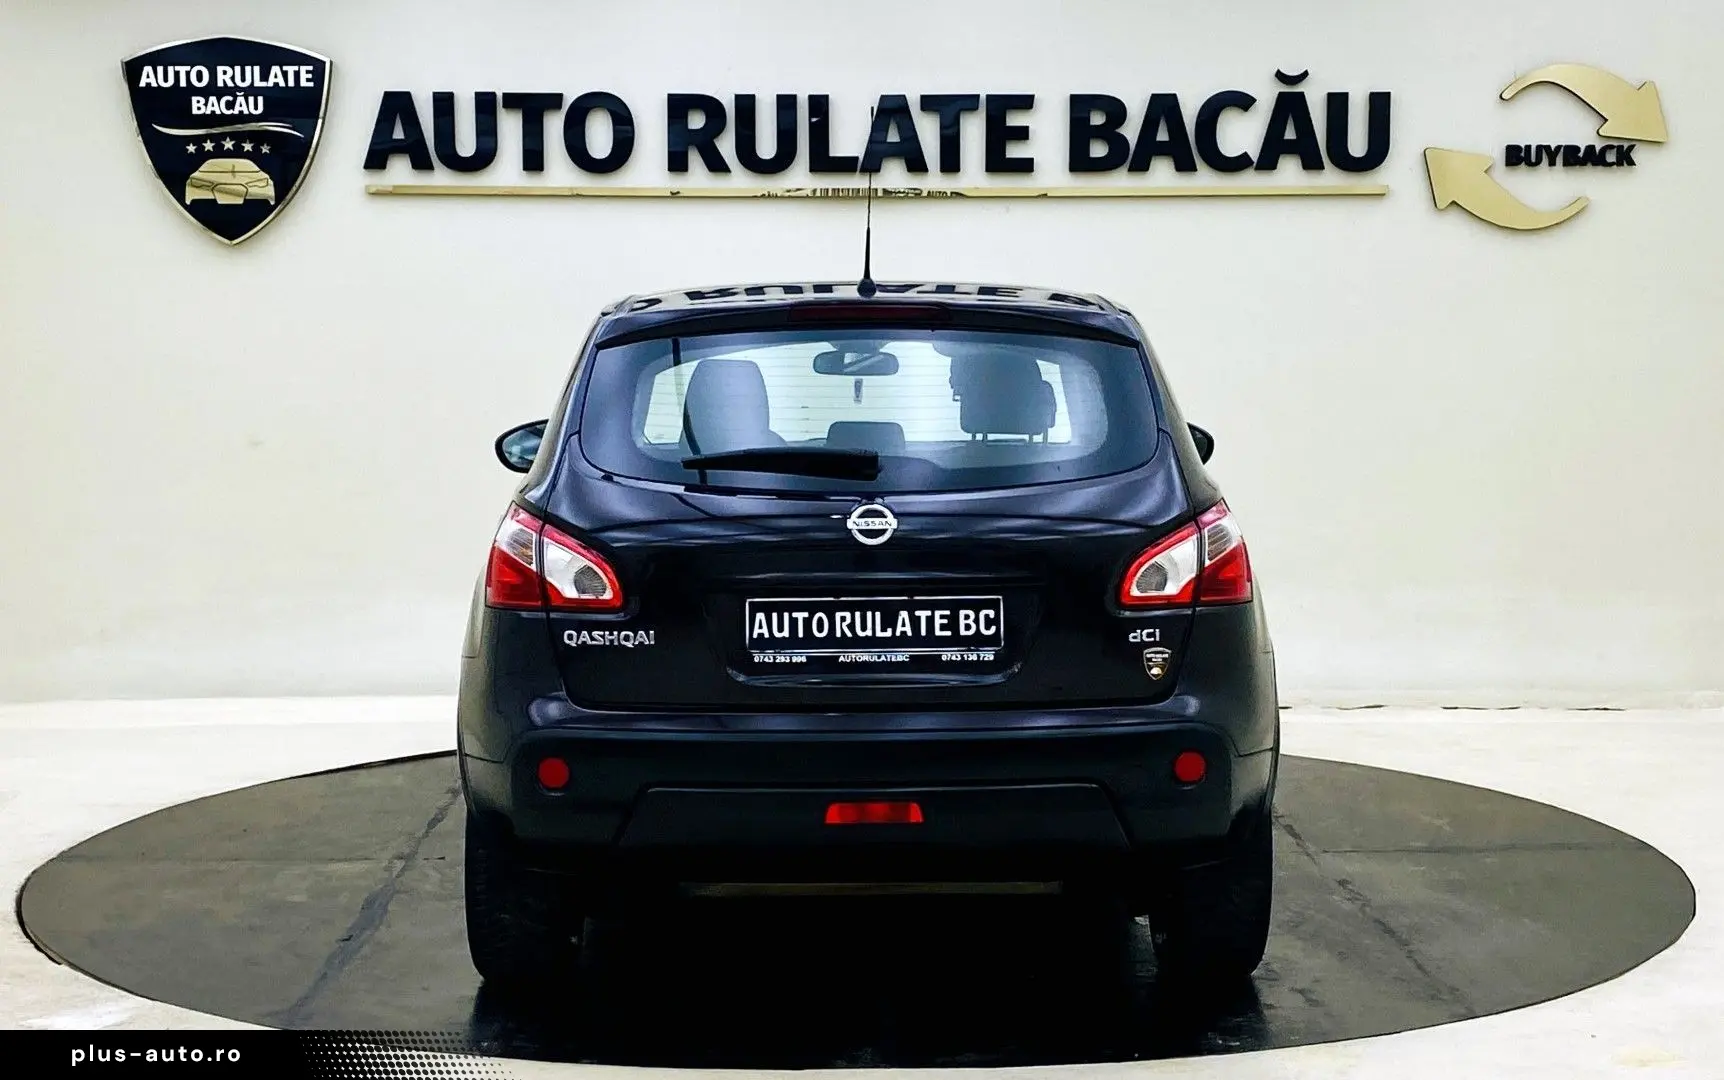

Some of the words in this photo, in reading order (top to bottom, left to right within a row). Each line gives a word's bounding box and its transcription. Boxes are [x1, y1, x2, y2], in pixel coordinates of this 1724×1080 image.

[139, 65, 210, 88] AUTO
[216, 65, 315, 88] RULATE
[191, 91, 264, 116] BACĂU
[363, 91, 636, 173] AUTO
[666, 93, 1036, 174] RULATE
[1068, 68, 1392, 174] BACĂU
[1504, 144, 1637, 168] BUYBACK
[752, 611, 829, 639] AUTO
[836, 609, 951, 638] RULATE
[958, 608, 997, 637] BC
[563, 629, 656, 648] QASHQAI
[838, 654, 910, 663] AUTORULATEBC
